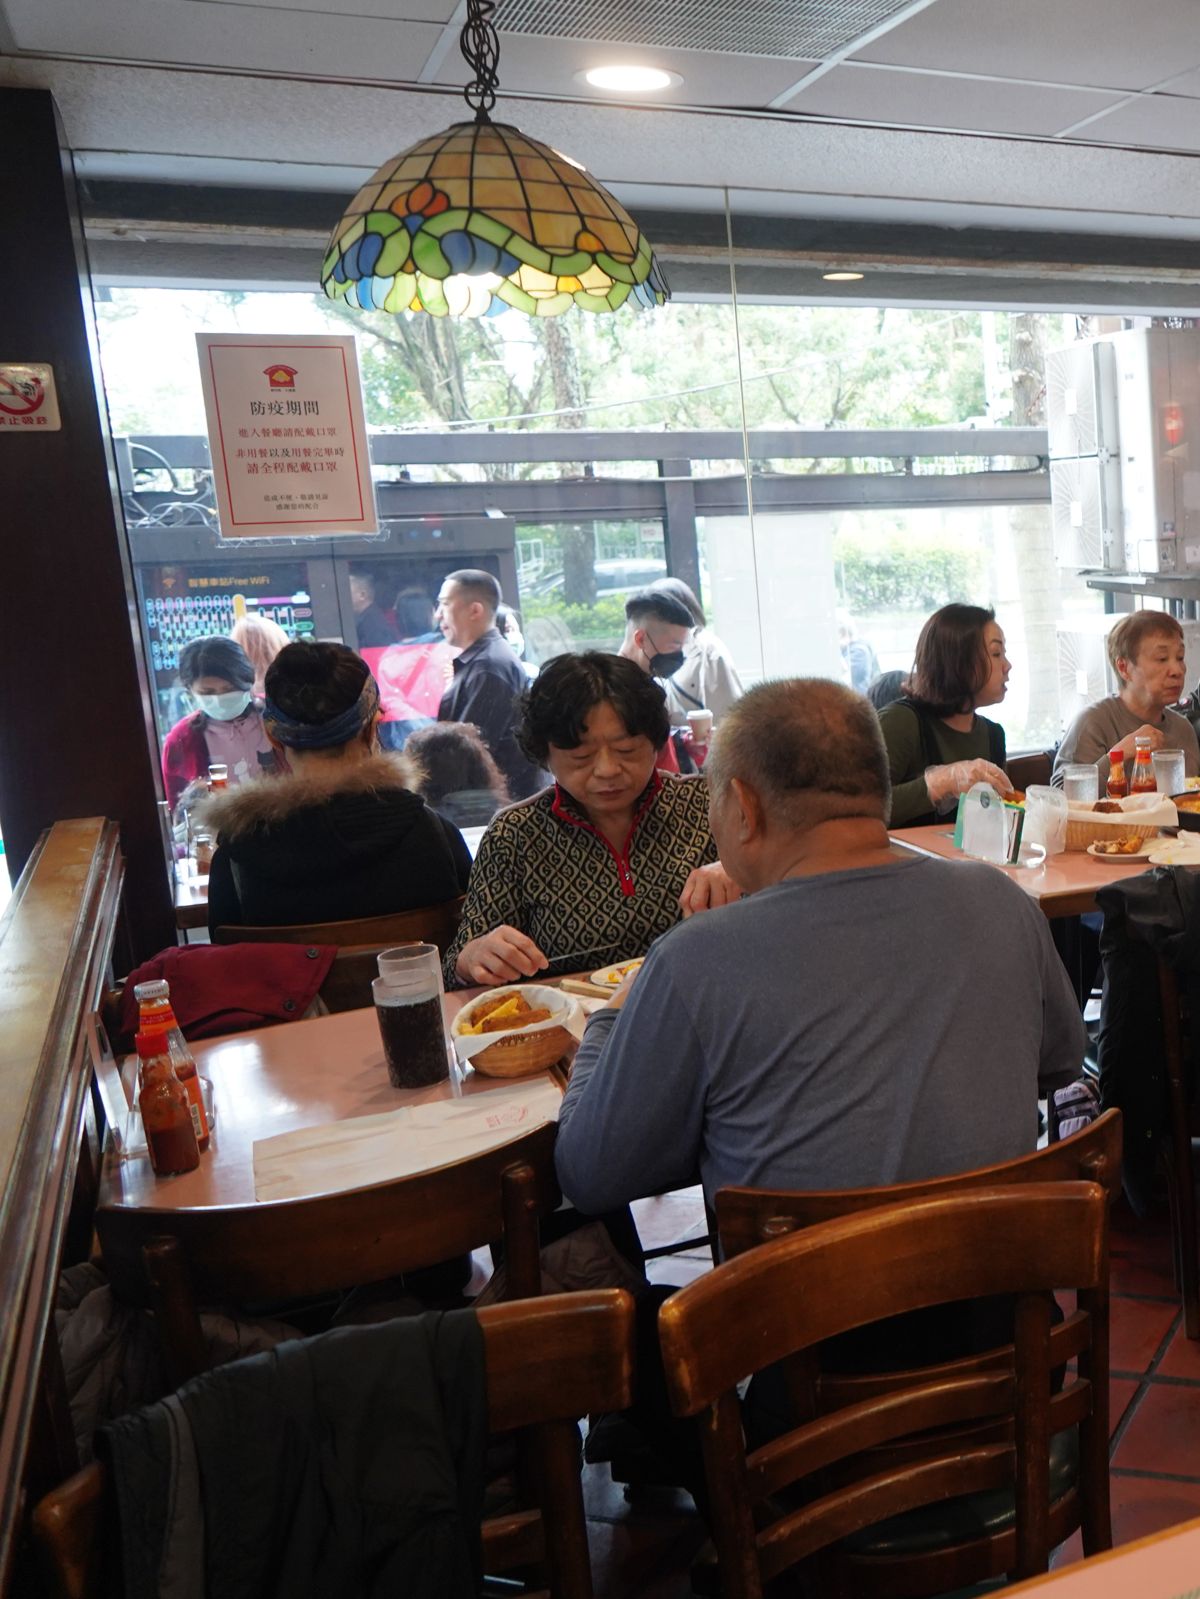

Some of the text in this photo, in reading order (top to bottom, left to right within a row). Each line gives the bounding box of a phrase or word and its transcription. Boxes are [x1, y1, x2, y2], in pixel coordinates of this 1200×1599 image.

[250, 400, 320, 417] 防疫期間
[247, 461, 339, 475] 請全程配戴口罩
